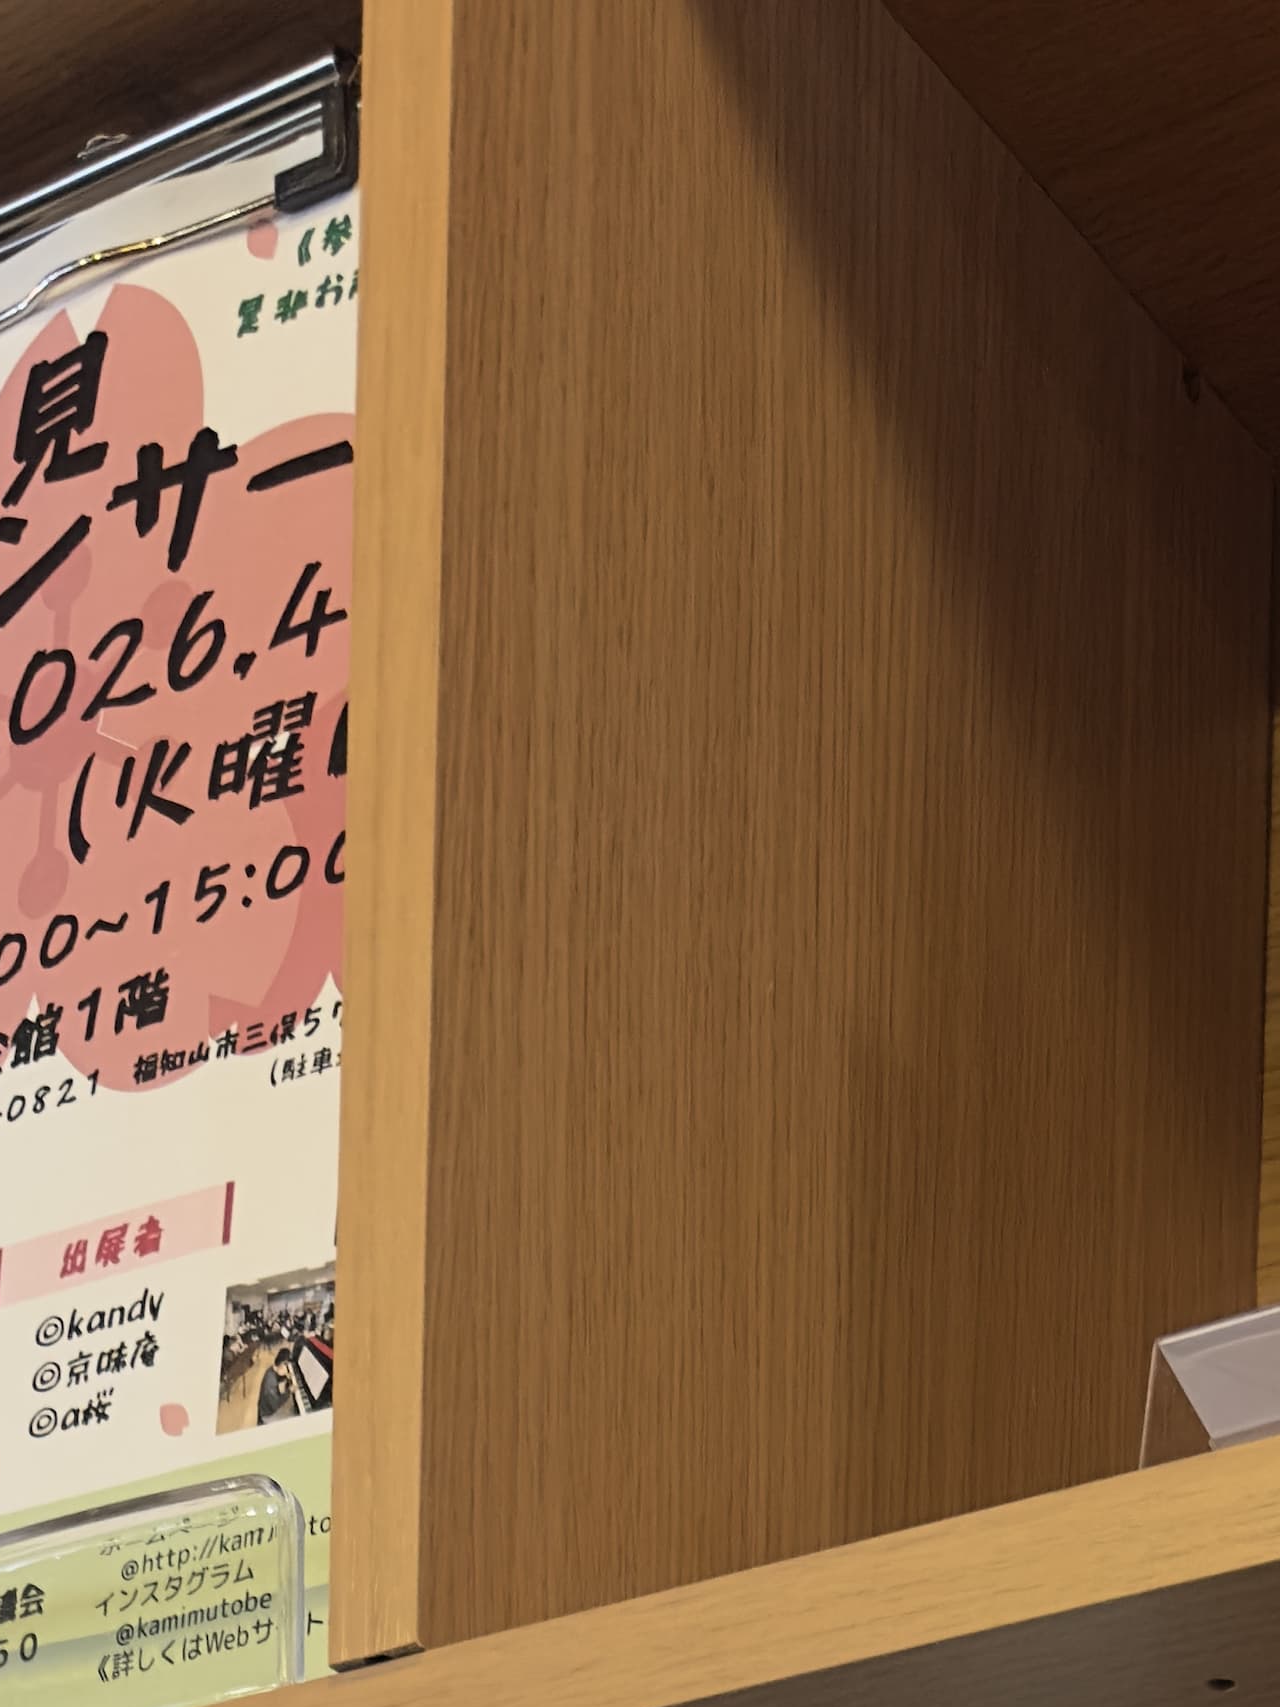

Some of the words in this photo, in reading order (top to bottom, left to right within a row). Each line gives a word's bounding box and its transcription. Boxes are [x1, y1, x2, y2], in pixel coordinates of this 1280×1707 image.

[95, 1560, 254, 1617] インスタグラム
[116, 1591, 273, 1647] @kamimutobe
